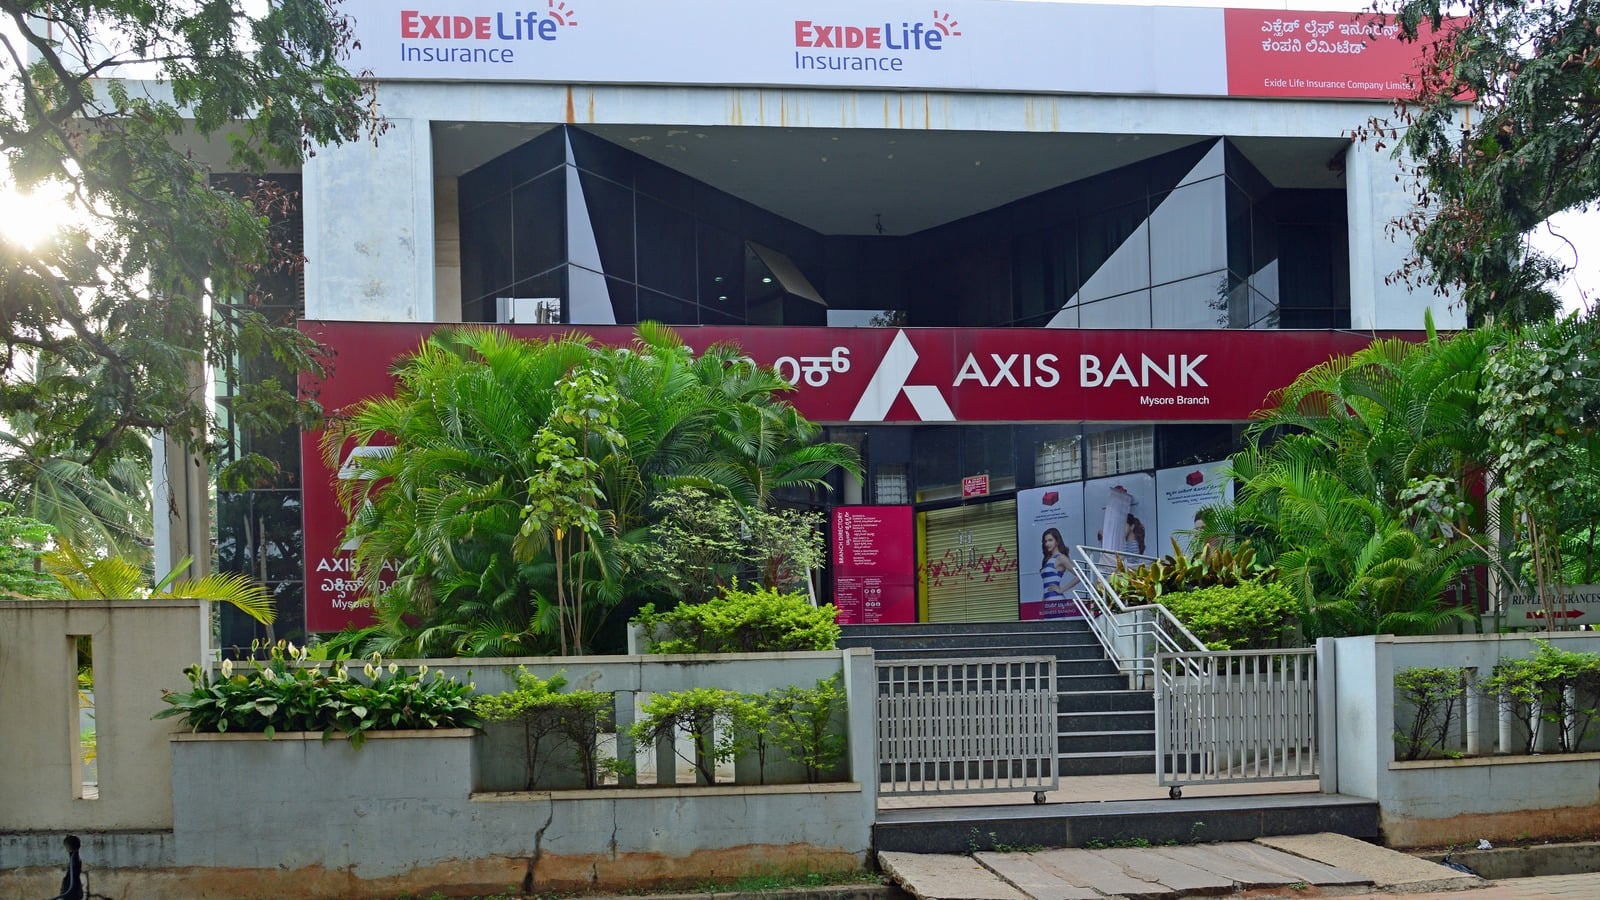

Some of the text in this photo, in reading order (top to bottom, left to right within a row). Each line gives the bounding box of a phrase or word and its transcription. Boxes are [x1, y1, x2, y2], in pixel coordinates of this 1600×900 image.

[401, 10, 557, 41] EXIDE Life
[794, 20, 942, 51] EXIDE Life
[1304, 19, 1335, 38] ಲೈಫ್
[401, 43, 514, 63] Insurance
[1262, 36, 1302, 52] ಕಂಪನಿ
[795, 51, 903, 71] Insurance
[1264, 78, 1287, 88] Exide
[1289, 79, 1304, 88] Life
[1306, 79, 1345, 89] Insurance
[1347, 80, 1384, 91] Company
[952, 352, 1209, 389] AXIS BANK
[1140, 395, 1210, 406] Mysore Branch
